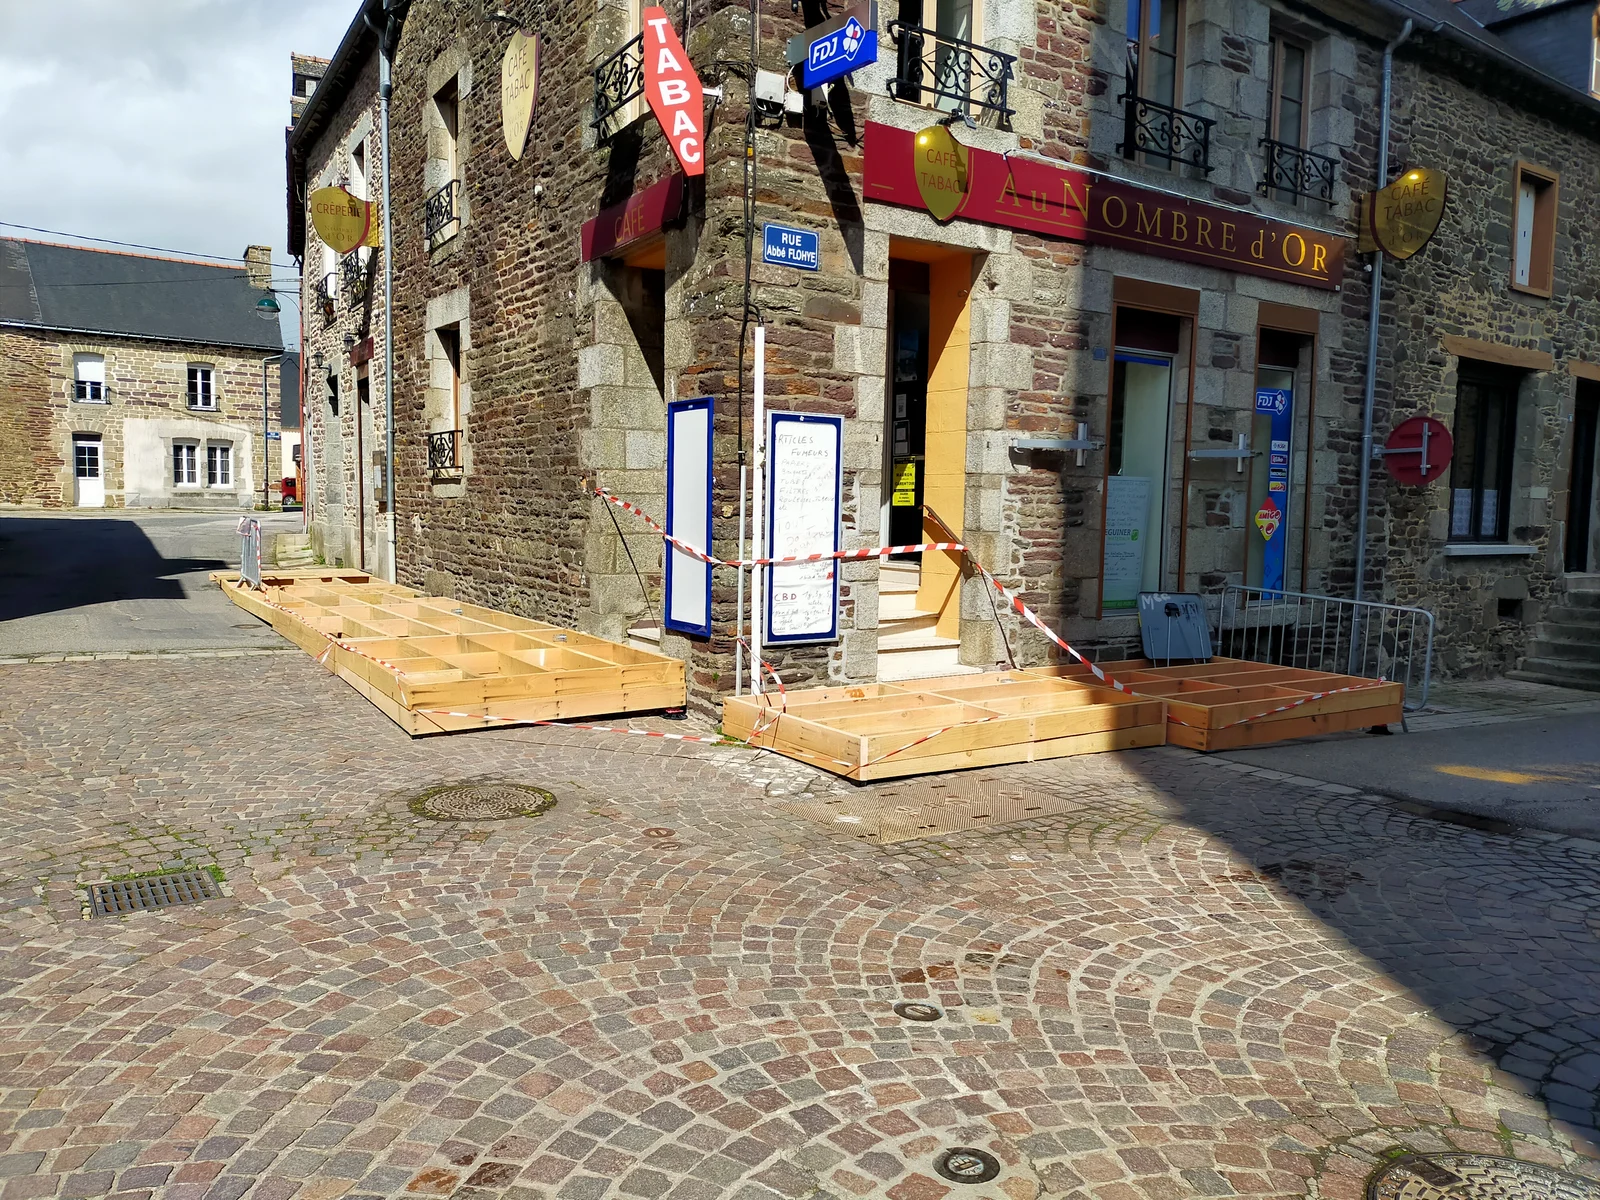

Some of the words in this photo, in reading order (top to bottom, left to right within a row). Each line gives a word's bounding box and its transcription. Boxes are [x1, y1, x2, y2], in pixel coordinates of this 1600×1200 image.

[507, 37, 528, 77] CAFÉ
[812, 36, 838, 65] FDJ
[505, 68, 531, 106] TABAC
[647, 17, 701, 163] TABAC
[927, 148, 957, 169] CAFÉ
[920, 171, 960, 194] TABAC
[1391, 176, 1430, 201] CAFÉ
[316, 201, 363, 218] CRÊPERIE
[614, 195, 645, 243] CAFÉ
[1059, 178, 1238, 254] NOMBRE
[1384, 198, 1436, 220] TABAC
[781, 232, 802, 247] RUE
[766, 244, 786, 259] Abbé
[788, 248, 816, 264] FLOHYE
[1258, 395, 1274, 407] FDJ
[776, 433, 814, 446] RTICLES
[791, 448, 829, 458] FUMEURS
[774, 592, 797, 601] CBD
